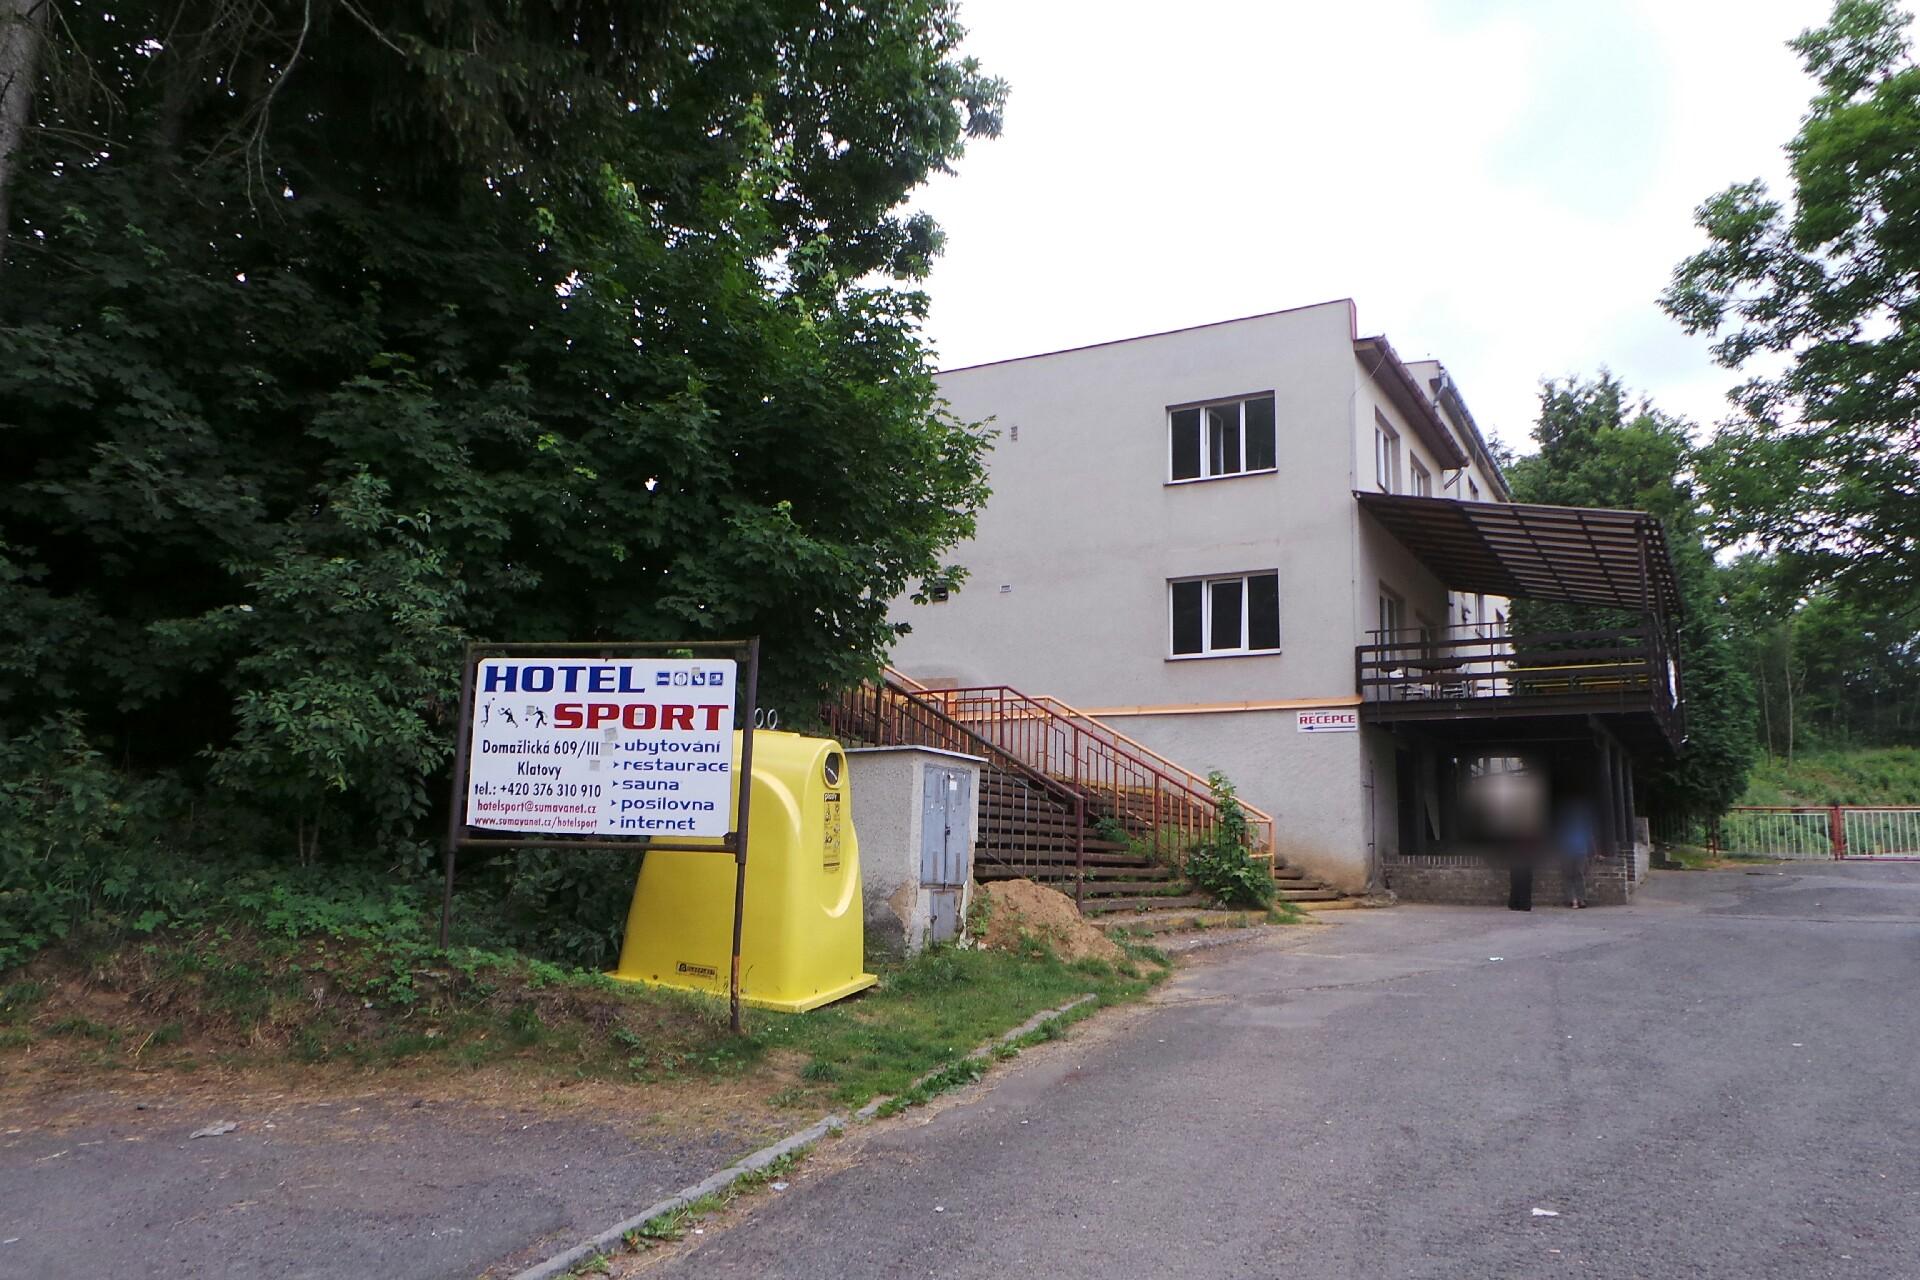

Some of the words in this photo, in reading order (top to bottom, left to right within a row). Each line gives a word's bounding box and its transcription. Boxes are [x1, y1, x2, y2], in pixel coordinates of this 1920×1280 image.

[484, 666, 645, 693] HOTEL
[554, 703, 729, 731] SPORT
[1299, 715, 1356, 725] RECEPCE
[482, 739, 550, 755] Domažlická
[553, 740, 599, 759] 609/III
[625, 739, 721, 755] ubytování
[517, 761, 562, 780] Klatovy
[623, 758, 728, 772] restaurace
[474, 781, 496, 795] tel.:
[500, 783, 529, 796] +420
[533, 783, 553, 796] 376
[556, 784, 577, 797] 310
[581, 784, 601, 798] 910
[622, 780, 679, 790] sauna
[477, 799, 596, 814] hotelsport@sumavanet.cz
[621, 797, 715, 812] posilovna
[474, 816, 597, 830] www.sumavanet.cz/hotelsport
[620, 816, 696, 830] internet
